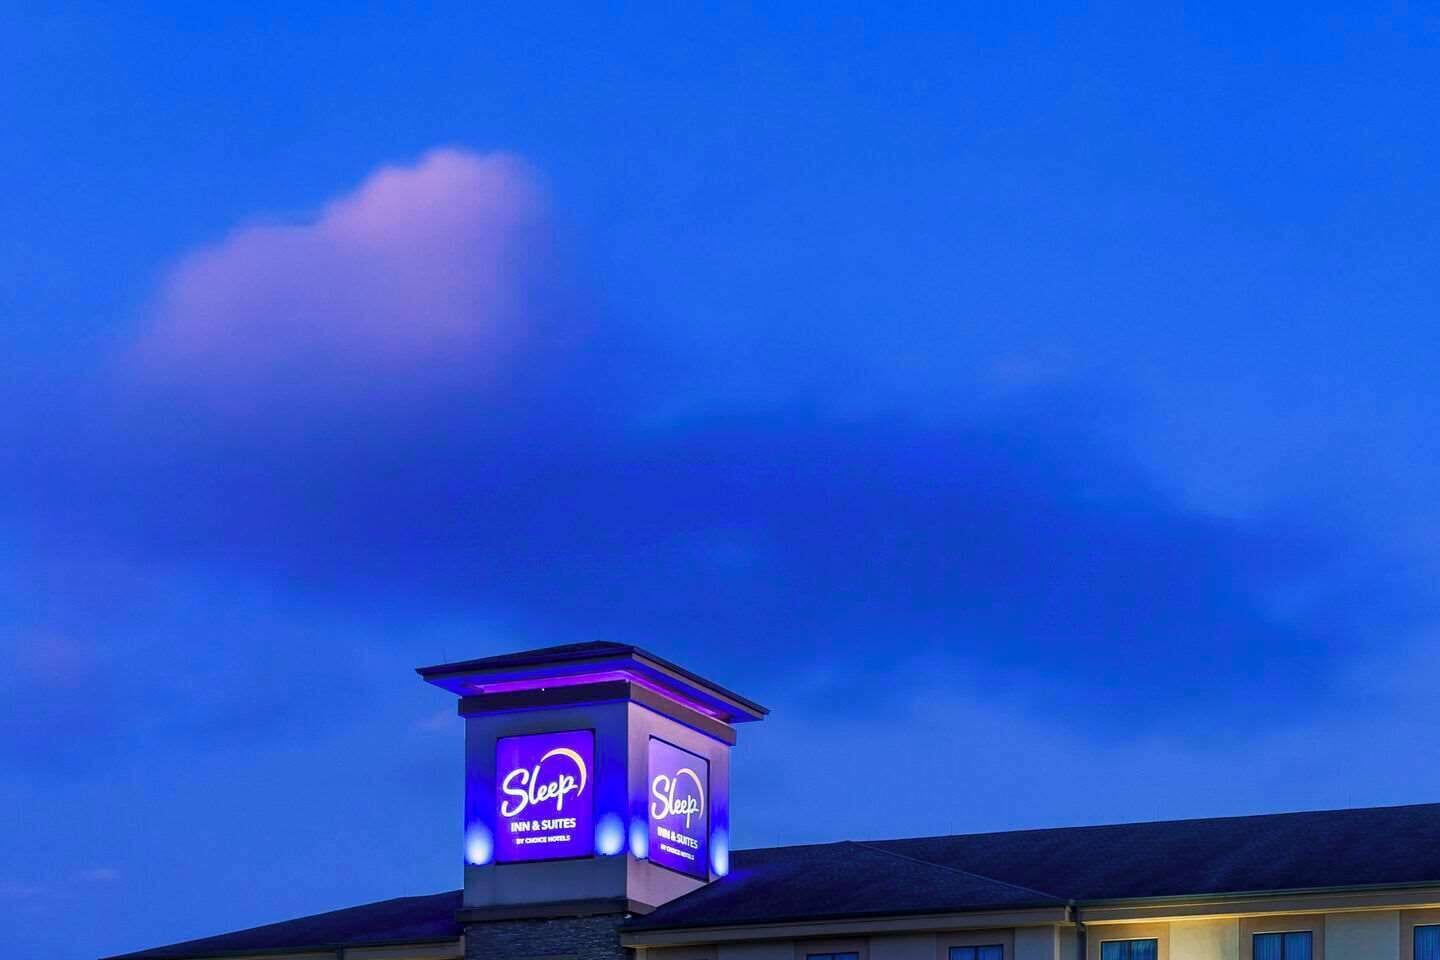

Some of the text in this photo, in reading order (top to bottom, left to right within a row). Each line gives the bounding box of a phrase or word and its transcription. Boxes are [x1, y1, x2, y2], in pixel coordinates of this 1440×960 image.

[501, 765, 577, 817] Sleep
[651, 774, 699, 829] Sleep
[511, 817, 576, 832] INN & SUITES
[676, 833, 698, 849] SUITES
